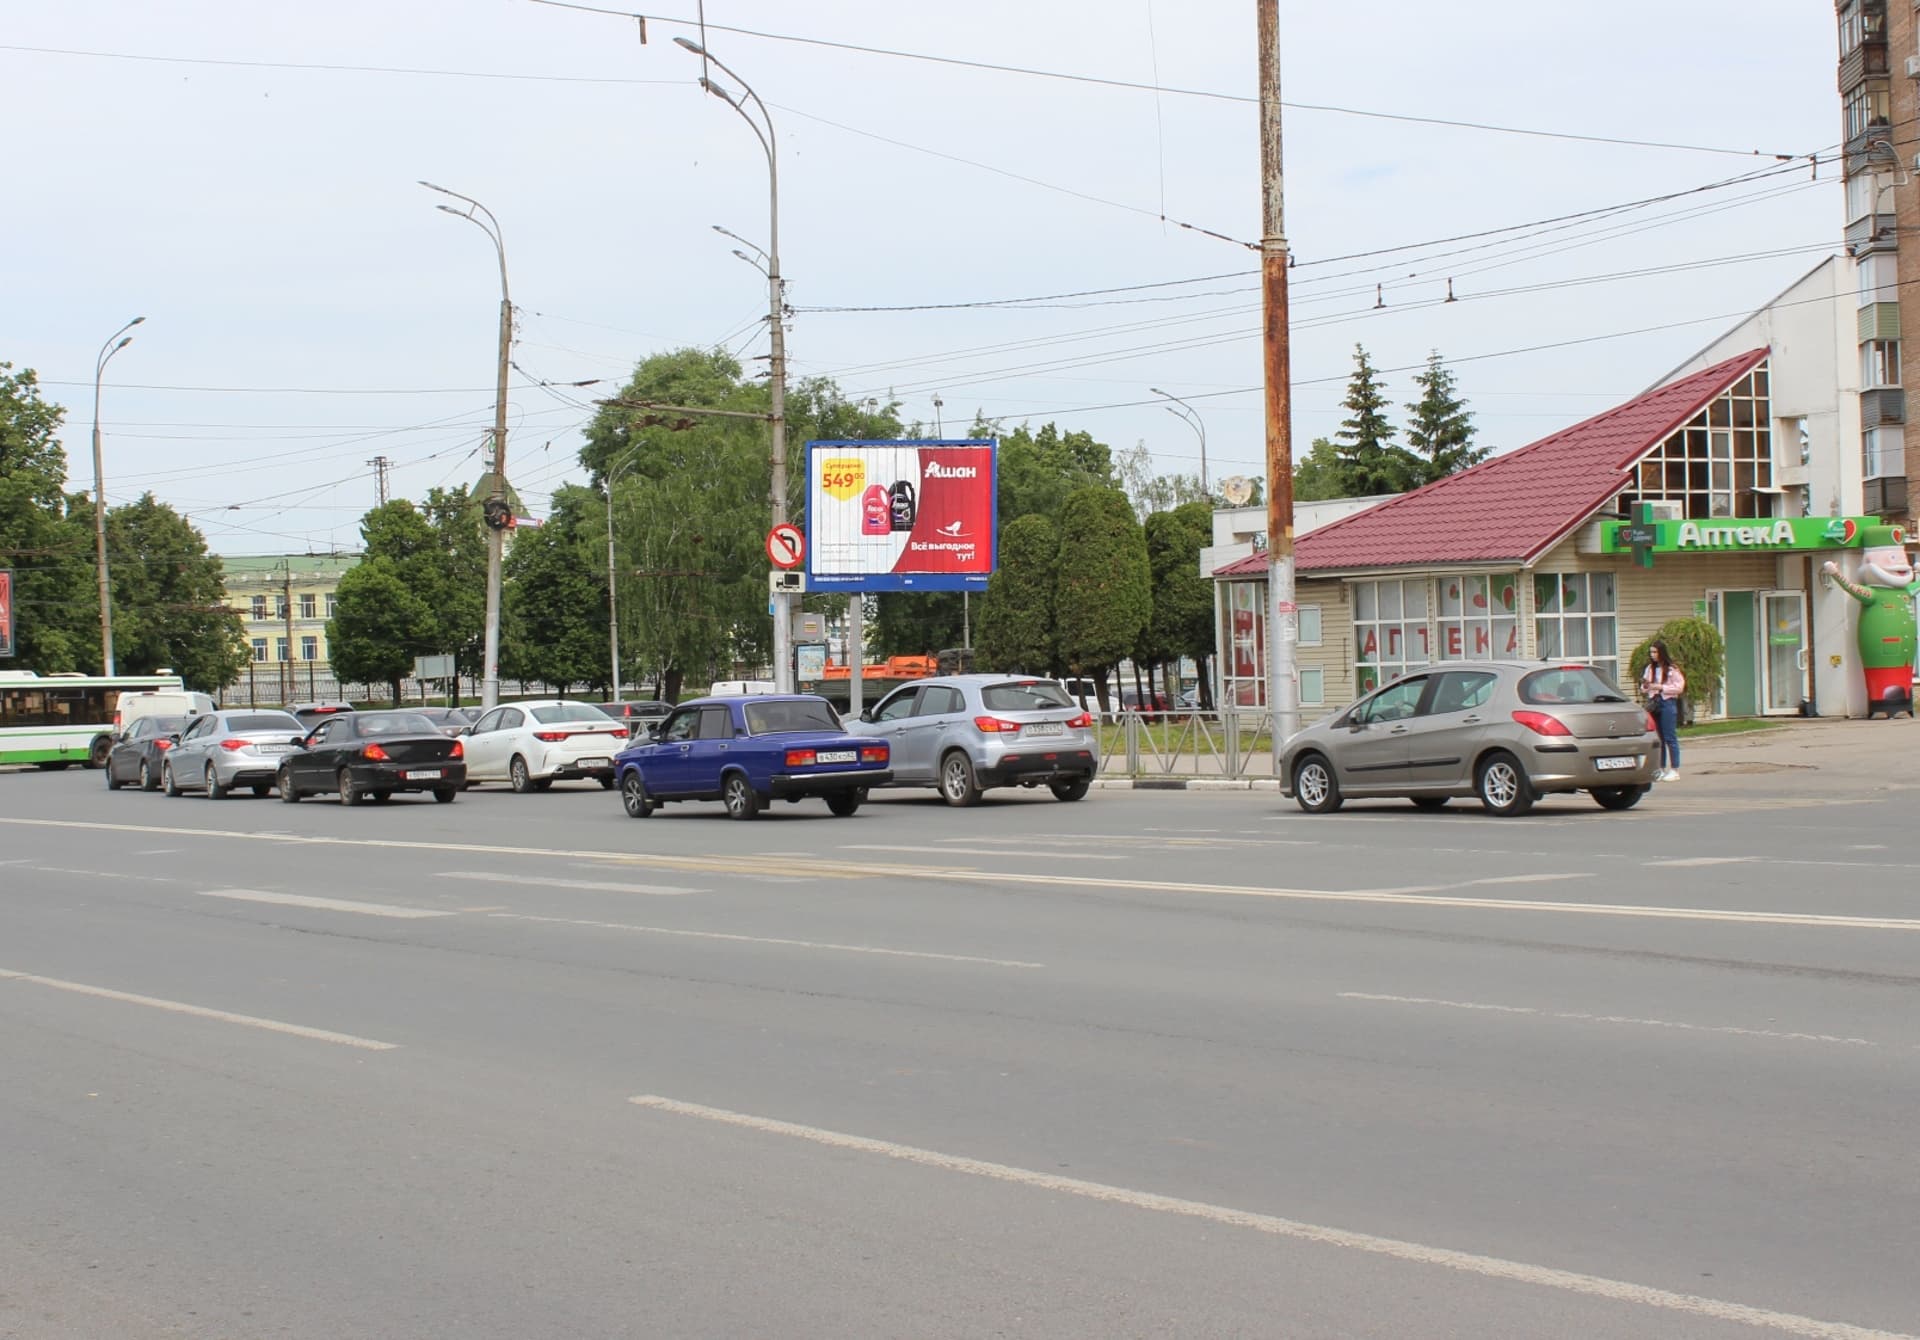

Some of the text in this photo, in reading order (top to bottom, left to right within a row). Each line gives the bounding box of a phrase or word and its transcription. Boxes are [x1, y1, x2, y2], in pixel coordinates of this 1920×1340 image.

[924, 461, 977, 478] Ашан
[823, 472, 854, 488] 549
[911, 541, 975, 552] Всё выгодное
[956, 552, 975, 562] тут!
